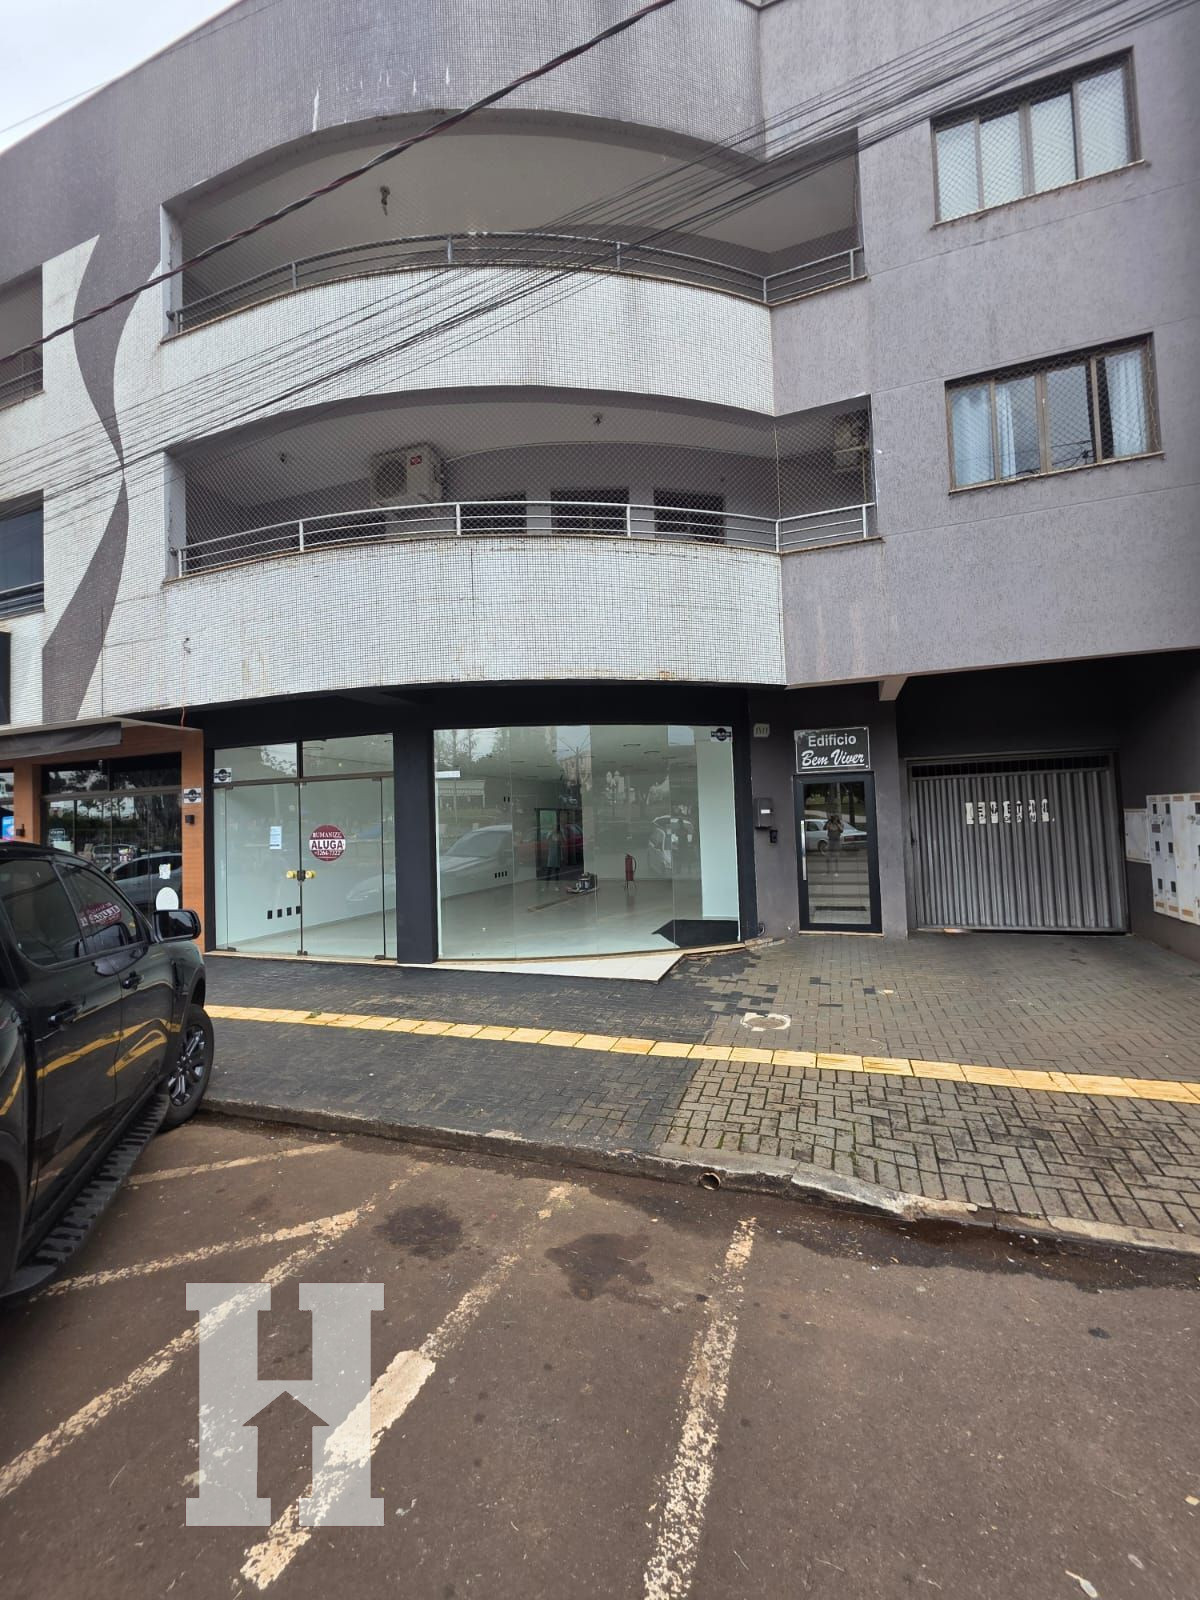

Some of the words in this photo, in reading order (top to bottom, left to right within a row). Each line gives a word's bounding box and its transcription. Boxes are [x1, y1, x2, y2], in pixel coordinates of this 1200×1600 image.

[808, 733, 857, 747] Edificio
[801, 750, 829, 766] Bem
[830, 749, 865, 766] Viver
[311, 840, 344, 850] ALUGA
